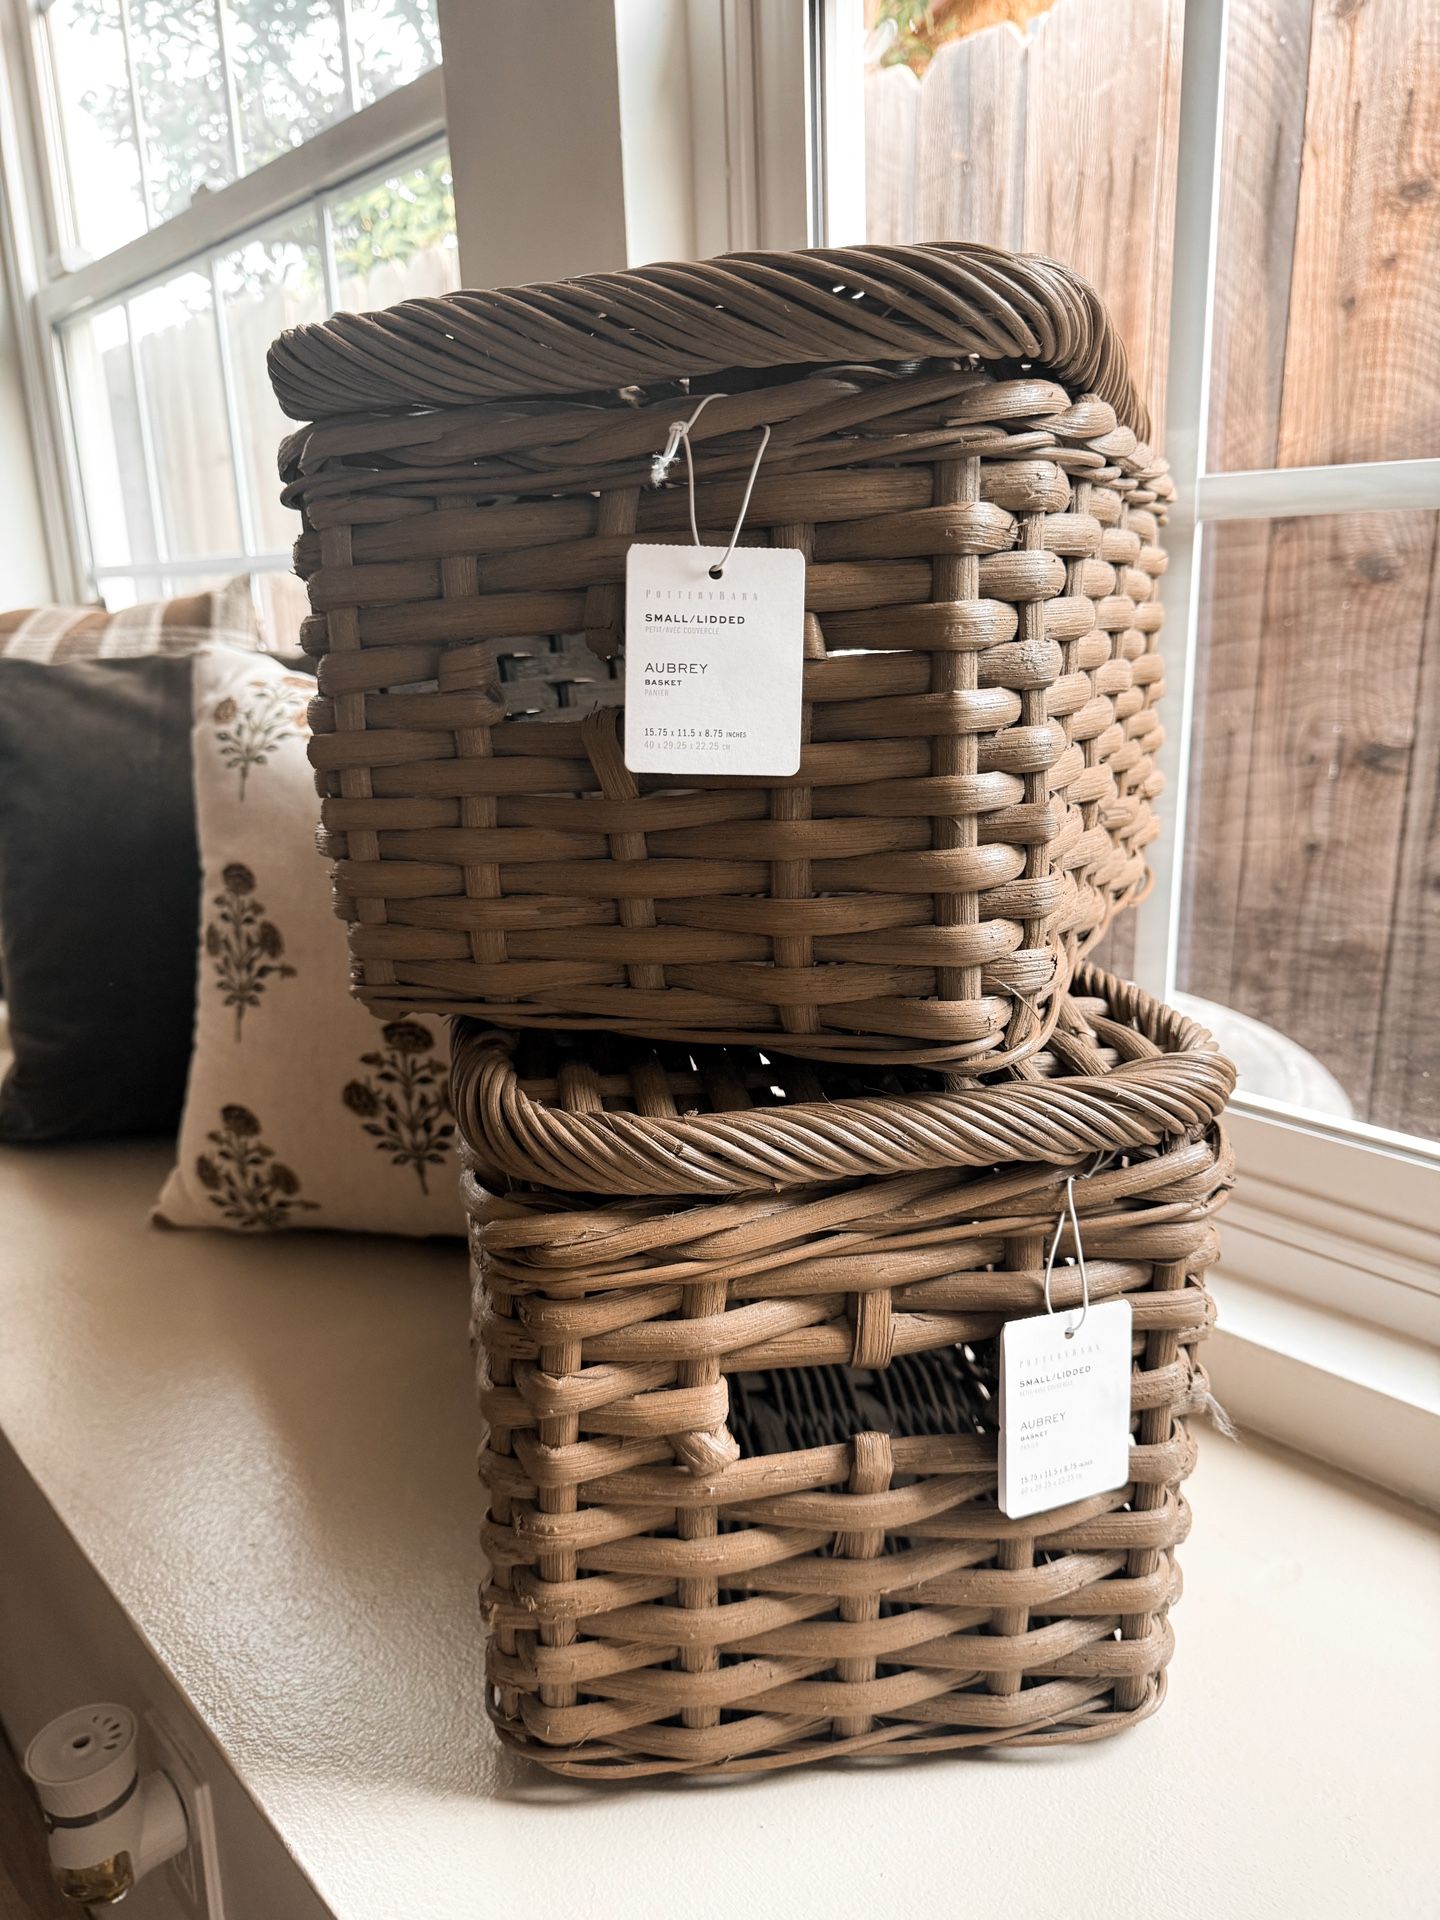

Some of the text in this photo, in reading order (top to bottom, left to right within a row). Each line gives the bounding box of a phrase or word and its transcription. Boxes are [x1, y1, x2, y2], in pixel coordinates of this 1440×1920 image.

[645, 613, 745, 625] SMALL/LIDDED
[644, 662, 708, 674] AUBREY
[644, 727, 668, 737] 15.75
[677, 728, 696, 737] 11.5
[704, 728, 723, 738] 8.75
[644, 740, 654, 749] 40
[663, 740, 687, 750] 29.25
[695, 741, 719, 751] 22.25
[1019, 1365, 1091, 1388] SMALL/LIDDED
[1020, 1411, 1066, 1431] AUBREY
